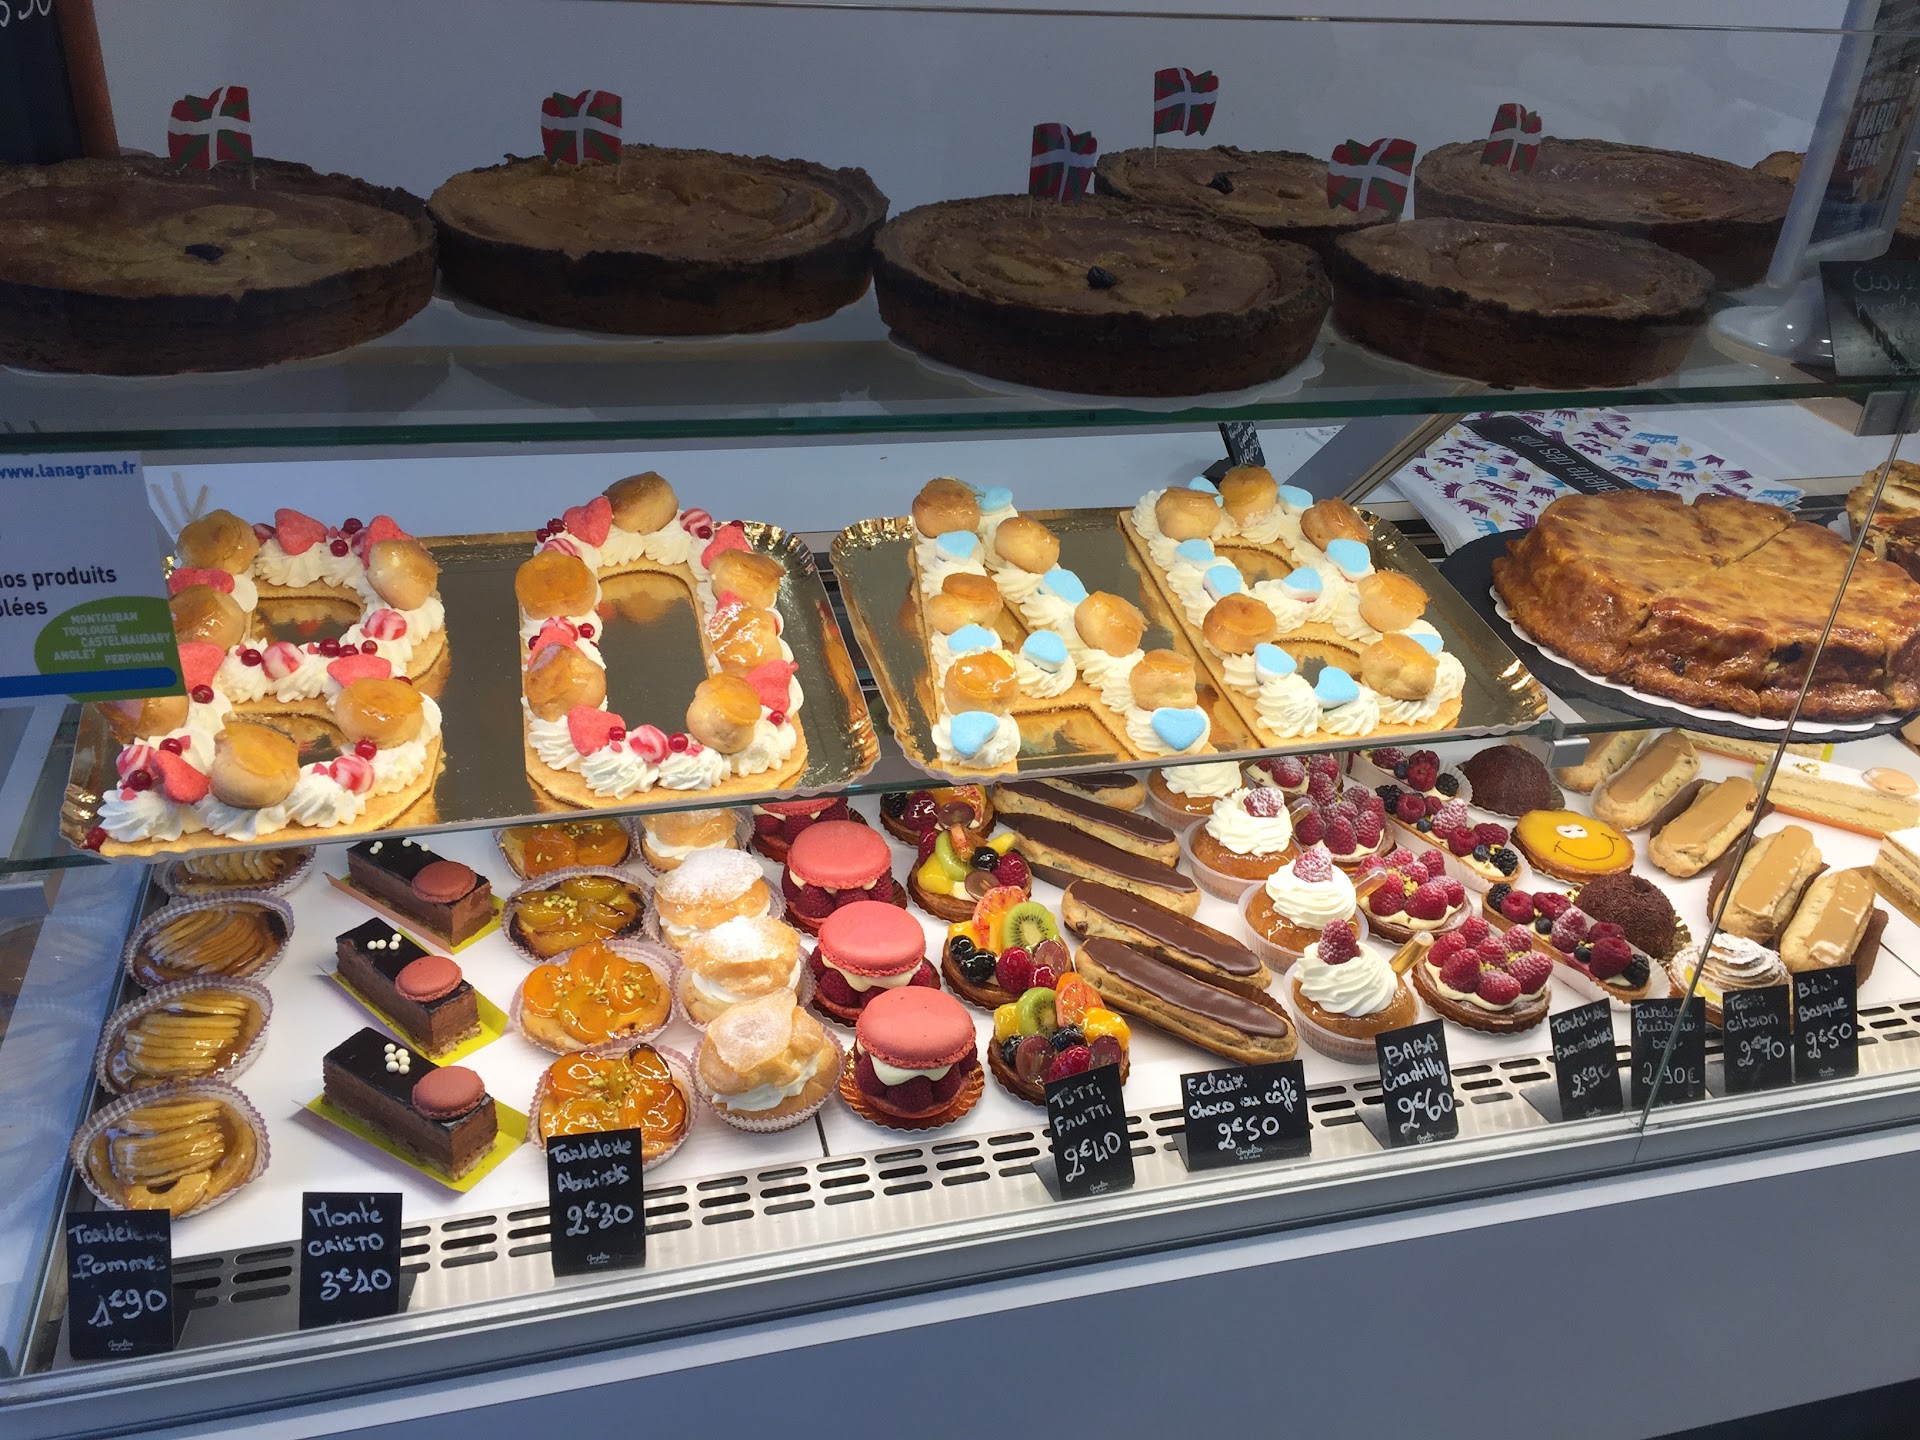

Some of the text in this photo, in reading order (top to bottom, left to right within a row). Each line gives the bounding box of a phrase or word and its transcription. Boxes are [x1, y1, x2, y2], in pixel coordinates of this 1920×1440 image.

[1539, 447, 1577, 466] des
[1566, 466, 1620, 492] alette
[32, 565, 117, 592] produits
[63, 624, 117, 637] TOULOUSE
[70, 612, 138, 625] MONTAUBAN
[81, 632, 171, 648] CASTELNAUDARY
[54, 649, 165, 665] ANGLET PERPIGNAN
[1631, 1003, 1693, 1019] Tartelee
[1798, 996, 1848, 1022] Basque
[1383, 1033, 1439, 1067] BABA
[1737, 1035, 1785, 1068] 2€70
[1805, 1023, 1853, 1059] 2€50
[1397, 1087, 1454, 1134] 2€60
[1217, 1115, 1280, 1151] 2€50
[1064, 1131, 1121, 1183] 2€40
[565, 1200, 634, 1237] 2€30
[319, 1267, 392, 1301] 3€10
[87, 1288, 168, 1328] 1€90
